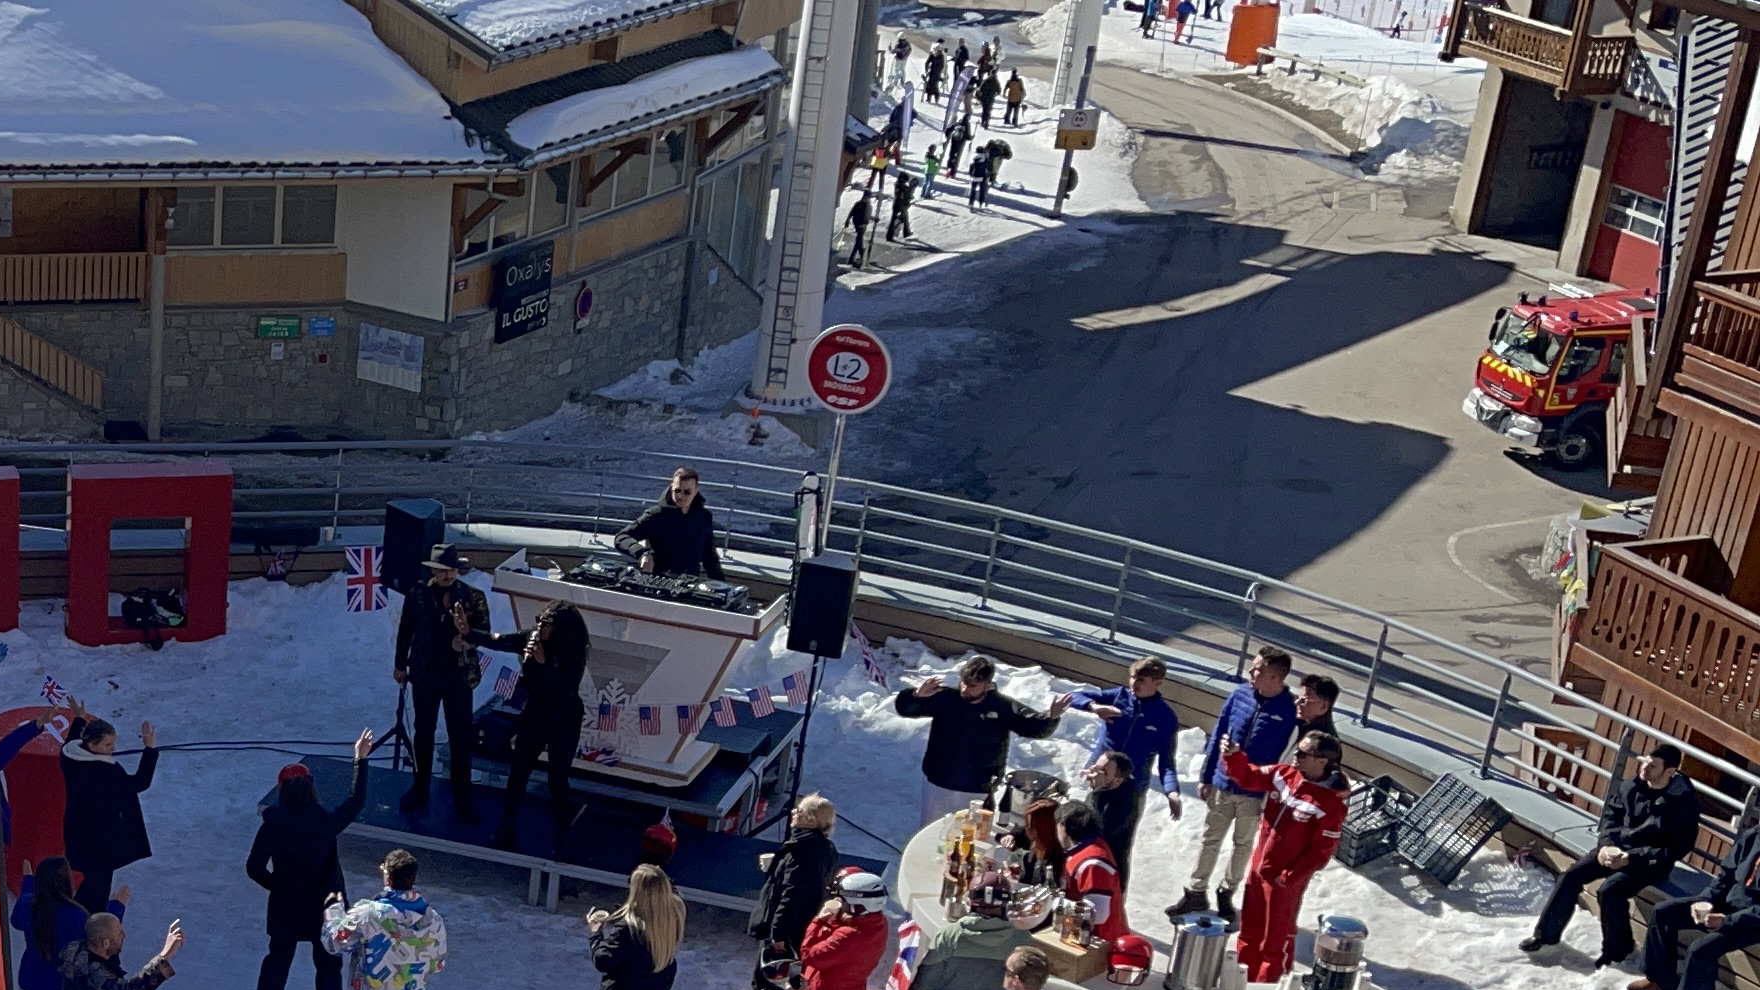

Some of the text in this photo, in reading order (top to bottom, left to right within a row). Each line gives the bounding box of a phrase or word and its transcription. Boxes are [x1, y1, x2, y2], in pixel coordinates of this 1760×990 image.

[506, 257, 551, 287] Oxalys
[502, 312, 512, 328] IL
[513, 298, 549, 323] GUSTO
[833, 355, 862, 380] L2
